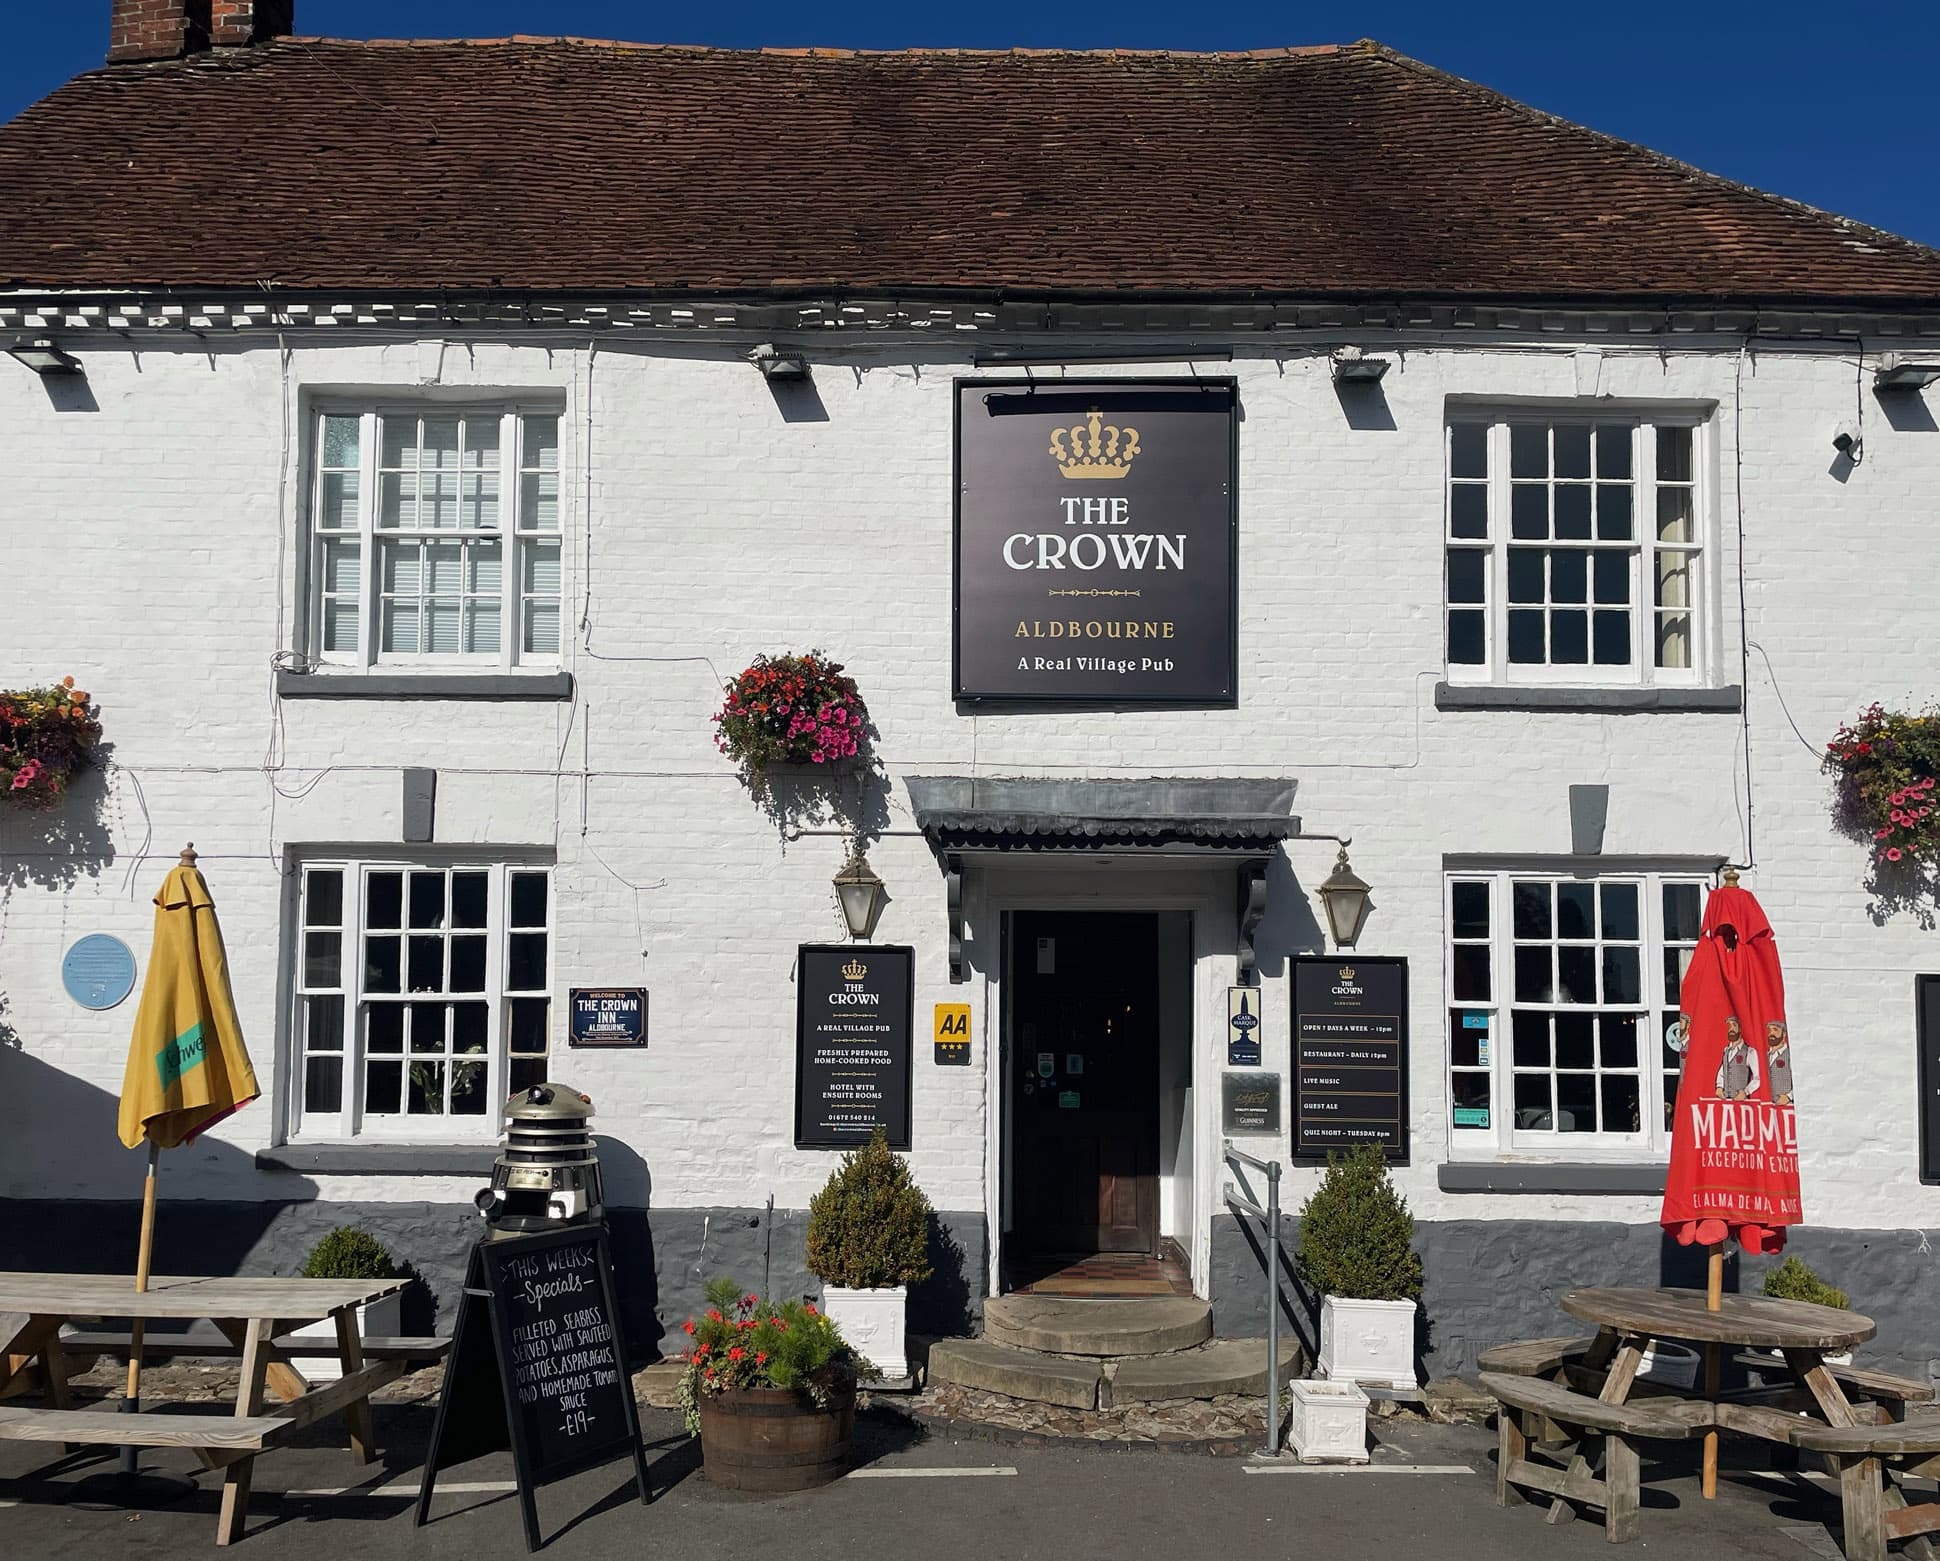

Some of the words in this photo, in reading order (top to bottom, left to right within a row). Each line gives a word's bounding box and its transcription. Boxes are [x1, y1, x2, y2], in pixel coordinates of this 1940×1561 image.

[1060, 497, 1130, 525] THE
[1002, 533, 1187, 570] CROWN
[1015, 621, 1175, 639] ALDBOURNE
[1017, 657, 1029, 670] A
[1034, 656, 1071, 671] Real
[1076, 657, 1136, 674] Village
[1141, 658, 1174, 672] Pub
[844, 983, 864, 993] THE
[1331, 986, 1363, 995] CROWN
[578, 1000, 599, 1012] THE
[601, 1000, 638, 1011] CROWN
[828, 993, 880, 1005] CROWN
[597, 1011, 616, 1023] INN
[940, 1014, 967, 1035] AA
[588, 1023, 626, 1032] ALDBOURNE
[814, 1057, 870, 1065] HOME-COOKED
[870, 1057, 892, 1065] FOOD
[817, 1049, 849, 1057] FRESHLY
[850, 1049, 889, 1057] PREPARED
[1703, 1193, 1734, 1209] ALMA
[1738, 1195, 1750, 1210] DE
[507, 1256, 539, 1279] THIS
[545, 1247, 588, 1273] WEEKS
[513, 1319, 557, 1344] FILLETED
[563, 1306, 602, 1331] SEABASS
[512, 1339, 548, 1364] SERVED
[551, 1332, 574, 1352] WITH
[576, 1323, 612, 1346] SAUTEED
[518, 1384, 538, 1405] AND
[540, 1373, 593, 1398] HOMEMADE
[592, 1369, 619, 1387] TOMATO
[559, 1392, 588, 1412] SAUCE
